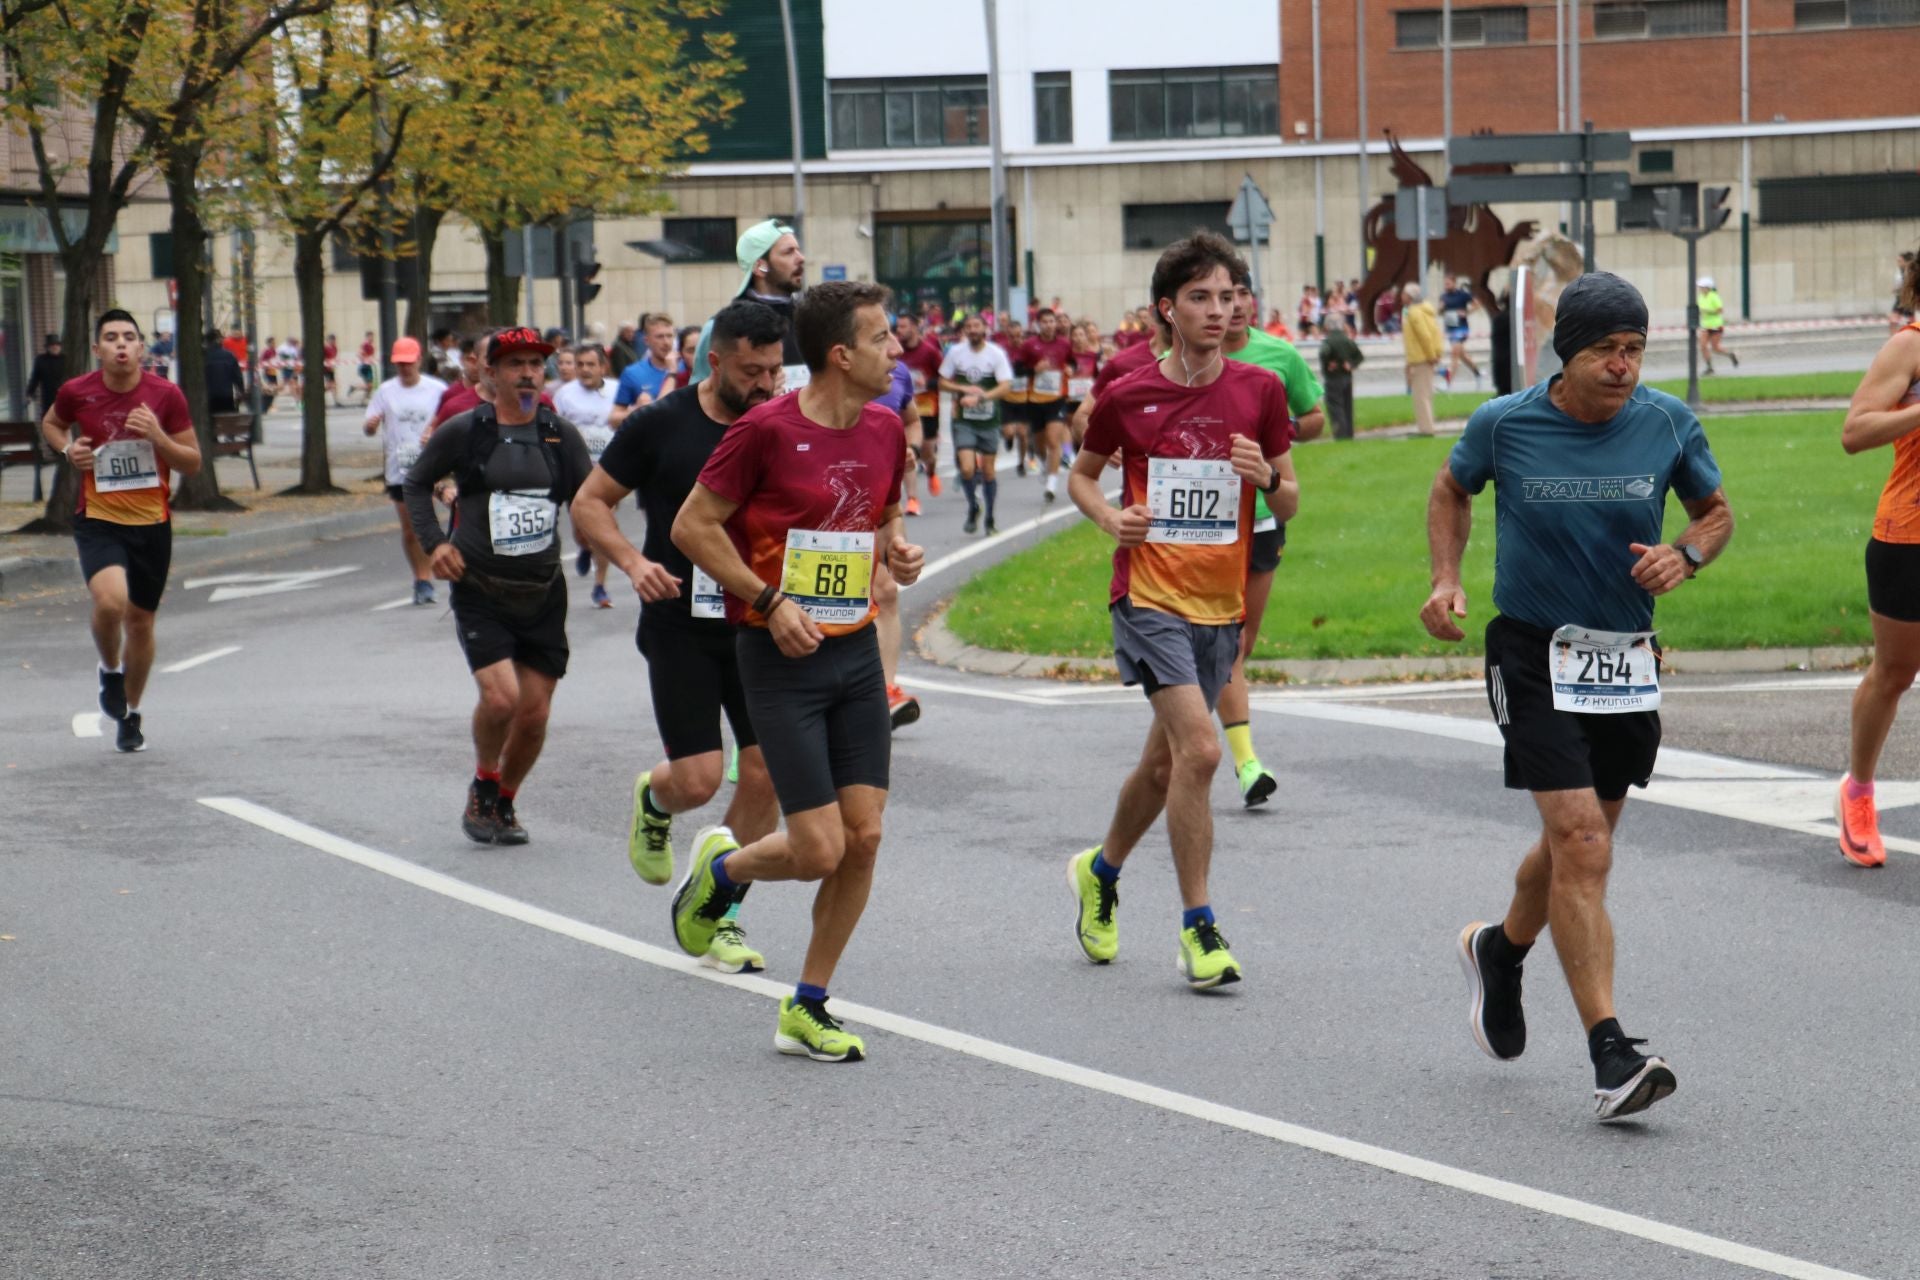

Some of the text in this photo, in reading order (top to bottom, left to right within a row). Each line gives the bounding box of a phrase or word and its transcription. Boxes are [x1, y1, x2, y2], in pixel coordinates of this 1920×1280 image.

[111, 457, 139, 476] 610
[1522, 481, 1599, 498] TRAIL
[1170, 489, 1219, 519] 602
[508, 509, 544, 536] 355
[820, 554, 848, 562] NOGALES
[814, 563, 848, 596] 68
[816, 608, 856, 617] HYUNDAI
[1576, 650, 1632, 684] 264
[1592, 697, 1643, 706] HYUNDAI
